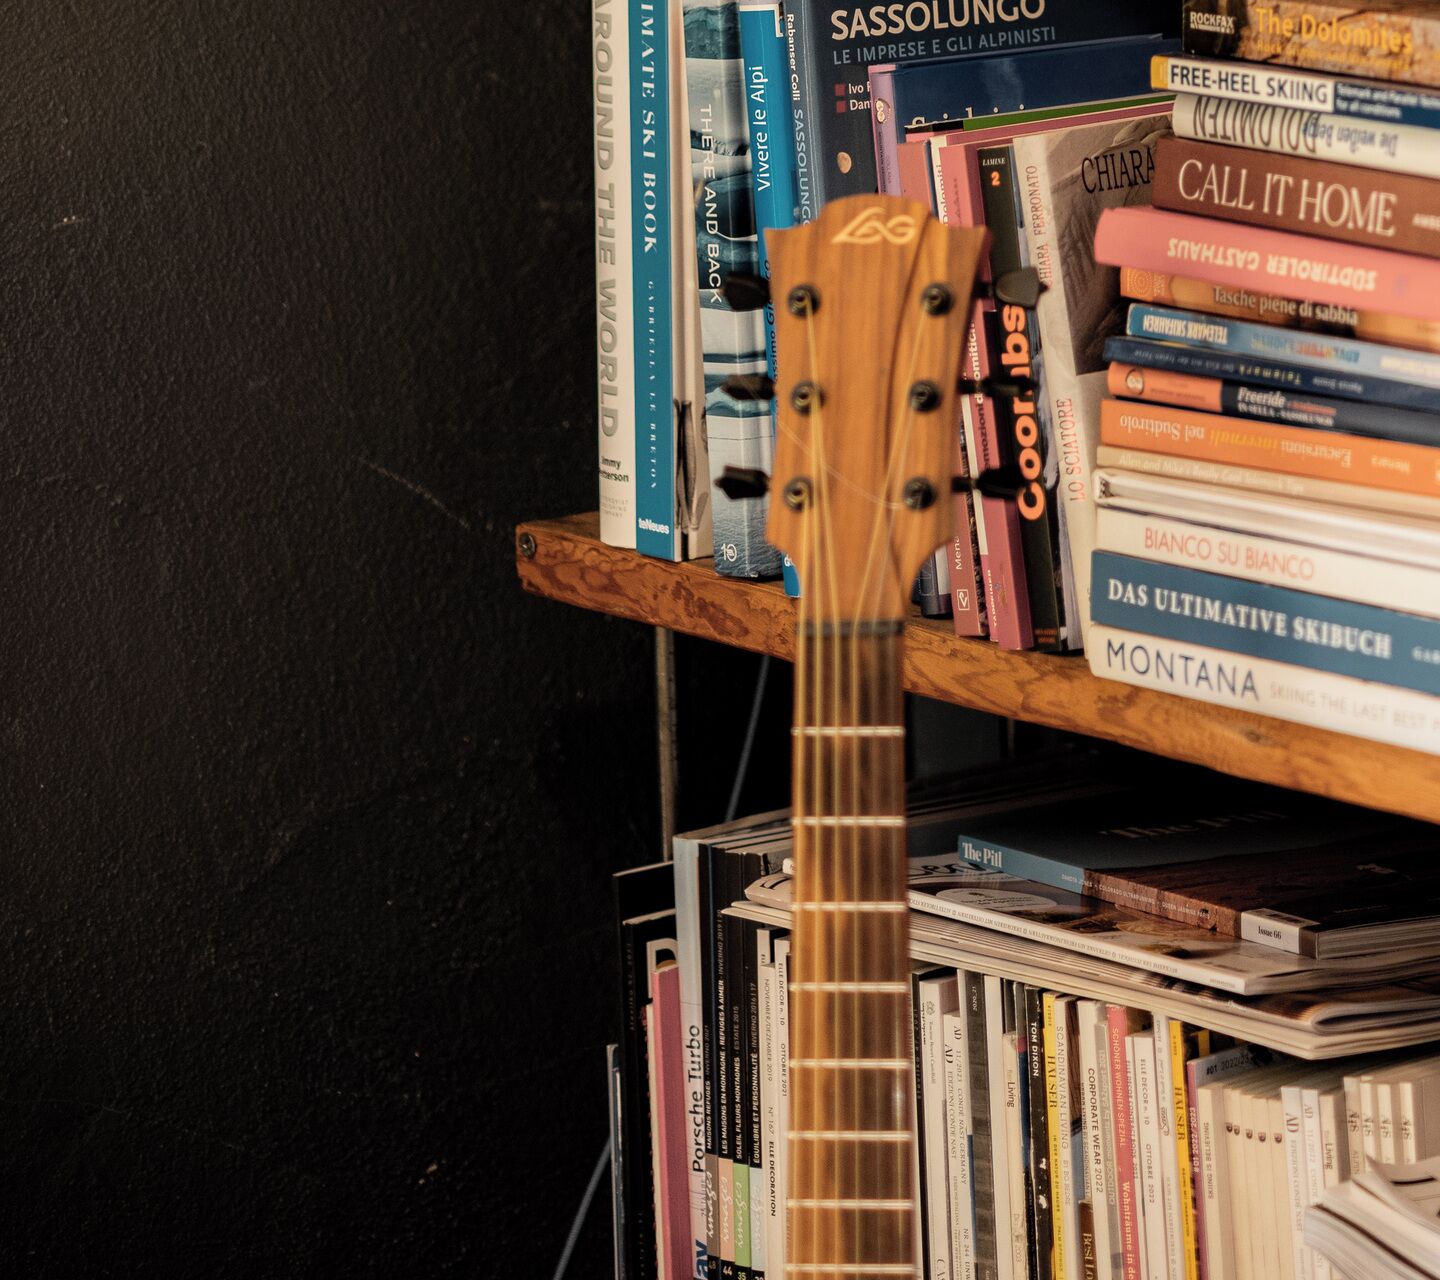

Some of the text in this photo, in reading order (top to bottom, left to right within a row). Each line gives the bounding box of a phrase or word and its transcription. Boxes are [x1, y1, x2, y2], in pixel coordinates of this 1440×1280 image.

[833, 26, 1056, 66] LE IMPRESE E GLI ALPINISTI
[1189, 11, 1235, 30] ROCKFAX
[1255, 9, 1293, 36] The
[1300, 13, 1413, 54] Dolomites
[786, 13, 800, 101] Rabanser Colli
[1170, 63, 1262, 98] FREE-HEEL
[1267, 76, 1329, 106] SKIING
[641, 110, 657, 159] SKI
[1192, 98, 1320, 156] DOLOMITEN
[981, 157, 1006, 167] LAMINE
[1080, 144, 1156, 195] CHIARA
[596, 183, 617, 265] THE
[642, 171, 659, 254] BOOK
[701, 104, 723, 304] THERE AND BACK
[1178, 158, 1254, 208] CALL
[1262, 174, 1292, 216] IT
[1300, 183, 1398, 237] HOME
[1166, 237, 1377, 293] SÜDTIROLER GASTHAUS
[598, 279, 619, 438] WORLD
[1055, 398, 1086, 503] LO SCIATORE
[1144, 527, 1315, 581] BIANCO SU BIANCO
[961, 841, 1003, 867] The Pill
[1257, 925, 1282, 940] Issue 66
[687, 1025, 704, 1173] Porsche Turbo
[750, 1053, 758, 1110] PERSONNALITÉ
[1006, 1082, 1016, 1108] Living
[1056, 1026, 1069, 1149] SCANDINAVIAN LIVING
[752, 1112, 759, 1122] ET
[1088, 1068, 1103, 1193] CORPORATE WEAR 2022
[1121, 1181, 1133, 1234] Wohnträume
